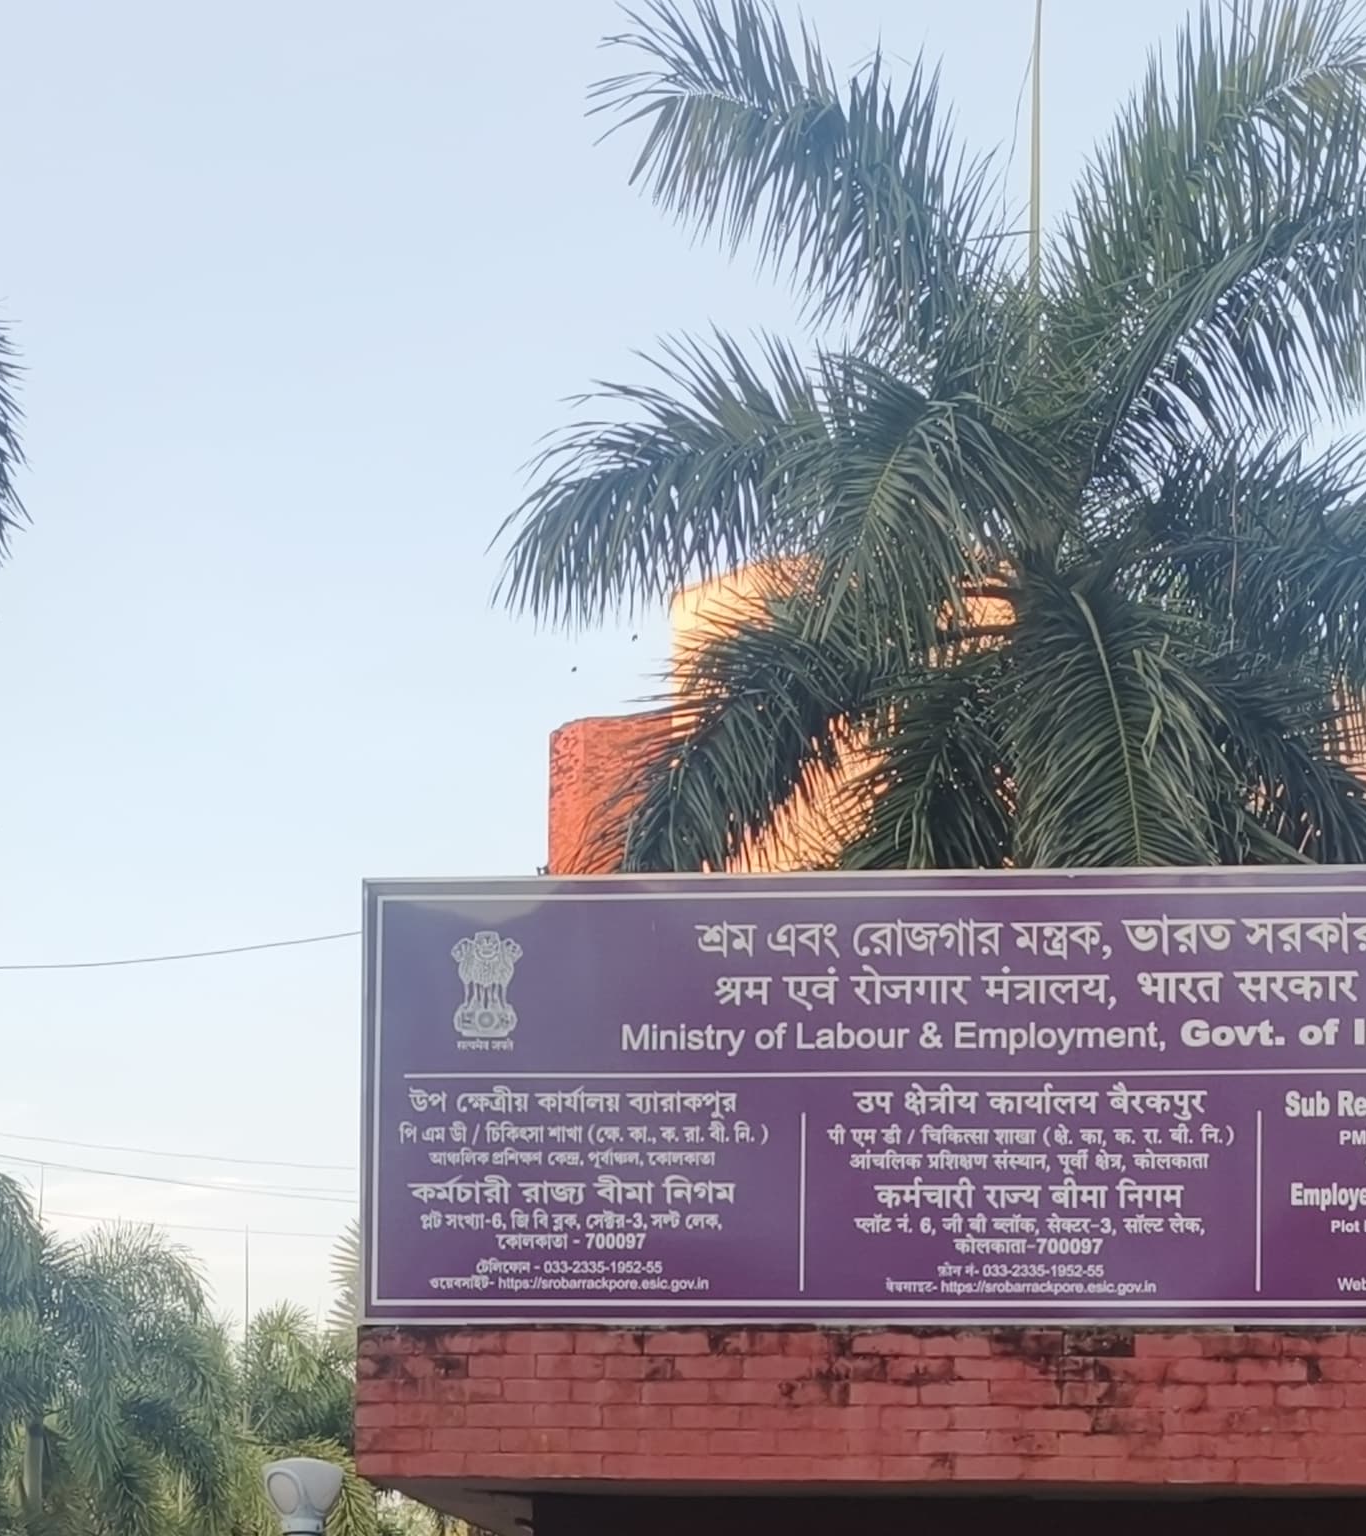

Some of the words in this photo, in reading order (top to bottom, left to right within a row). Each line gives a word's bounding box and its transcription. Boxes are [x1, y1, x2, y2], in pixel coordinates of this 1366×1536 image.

[694, 920, 758, 958] শ্রম
[767, 922, 841, 959] এবং
[853, 917, 1004, 958] রোজগার
[1010, 920, 1113, 961] মন্ত্রক,
[1121, 913, 1236, 955] ভারত
[714, 975, 773, 1006] श्रम
[782, 966, 840, 1011] एवं
[849, 966, 972, 1006] रोजगार
[980, 966, 1118, 1011] मंत्रालय,
[1137, 970, 1225, 1005] भारत
[1233, 969, 1360, 1003] सरकार
[622, 1022, 746, 1057] Ministry
[755, 1021, 789, 1051] of
[796, 1021, 911, 1050] Labour
[919, 1021, 944, 1049] &
[955, 1020, 1167, 1056] Employment,
[1180, 1018, 1286, 1048] Govt.
[1299, 1017, 1341, 1047] of
[408, 1087, 448, 1113] উপ
[852, 1090, 894, 1115] उप
[904, 1083, 979, 1115] क्षेत्रीय
[986, 1082, 1099, 1115] कार्यालय
[1106, 1081, 1209, 1121] बैरकपुर
[1285, 1090, 1331, 1118] Sub
[422, 1126, 446, 1143] এম
[547, 1125, 583, 1144] শাখা
[827, 1123, 847, 1145] पी
[850, 1129, 878, 1148] एम
[881, 1124, 903, 1145] डी
[920, 1124, 990, 1145] चिकित्सा
[992, 1129, 1037, 1145] शाखा
[1113, 1129, 1137, 1145] क.
[1142, 1128, 1163, 1145] रा.
[646, 1151, 716, 1167] কোলকাতা
[849, 1149, 923, 1170] आंचलिक
[926, 1149, 989, 1170] प्रशिक्षण
[992, 1149, 1051, 1173] संस्थान,
[1132, 1149, 1211, 1170] कोलकाता
[407, 1175, 512, 1205] কর্মচারী
[518, 1179, 586, 1206] রাজ্য
[592, 1174, 656, 1205] বীমা
[661, 1174, 737, 1205] নিগম
[874, 1177, 976, 1209] कर्मचारी
[983, 1184, 1043, 1209] राज्य
[1048, 1177, 1110, 1210] बीमा
[1115, 1177, 1186, 1210] निगम
[853, 1213, 892, 1235] प्लॉट
[920, 1216, 937, 1236] 6,
[942, 1213, 963, 1234] जी
[966, 1213, 987, 1234] बी
[1168, 1213, 1206, 1236] लेक,
[1331, 1218, 1360, 1234] Plot
[495, 1232, 568, 1250] কোলকাতা
[585, 1232, 647, 1250] 700097
[952, 1234, 1104, 1255] कोलकाता-700097
[543, 1260, 664, 1275] 033-2335-1952-55
[982, 1263, 1105, 1278] 033-2335-1952-55
